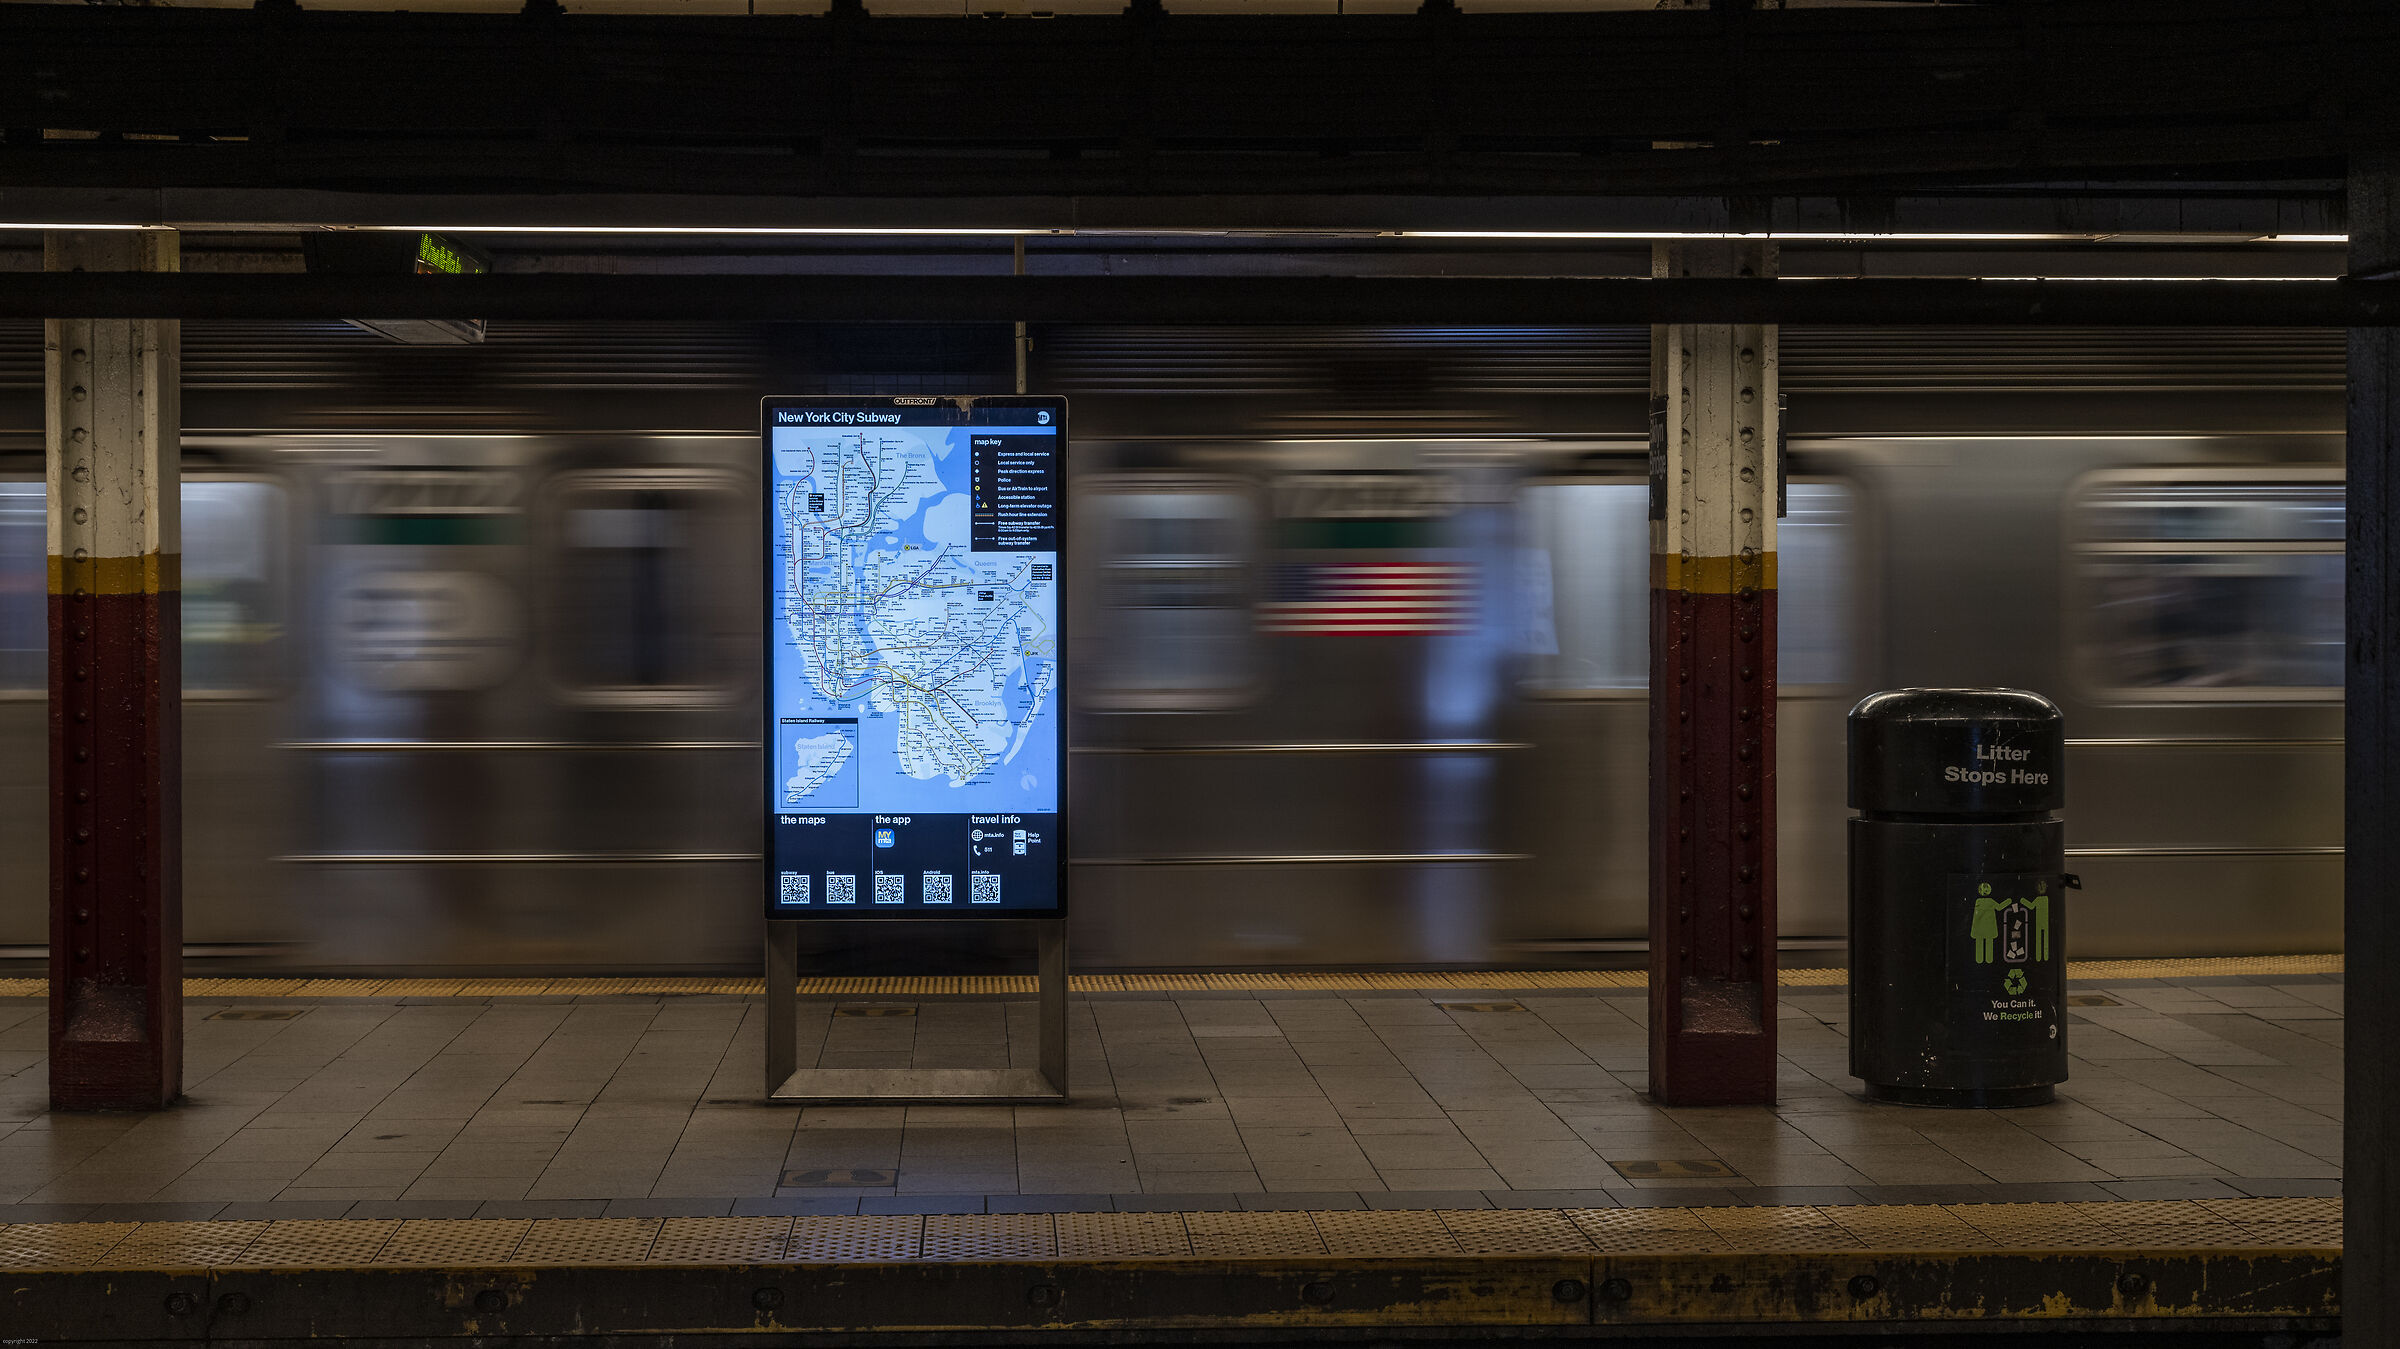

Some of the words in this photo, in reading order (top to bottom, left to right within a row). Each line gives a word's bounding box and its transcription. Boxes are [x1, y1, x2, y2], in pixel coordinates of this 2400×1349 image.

[778, 412, 803, 422] New
[805, 412, 831, 422] York
[832, 412, 854, 424] City
[856, 412, 901, 424] Subway
[990, 438, 1002, 446] key
[1976, 744, 2031, 762] Litter
[1945, 766, 2006, 787] Stops
[2011, 768, 2049, 785] Here
[781, 816, 797, 824] the
[798, 817, 826, 826] maps
[875, 815, 891, 824] the
[892, 816, 911, 825] app
[971, 815, 999, 824] travel
[1001, 815, 1021, 824] info
[1991, 999, 2008, 1009] You
[2010, 1000, 2026, 1008] Can
[2028, 999, 2036, 1007] it.
[1983, 1012, 1998, 1020] We
[2000, 1011, 2034, 1021] Recycle
